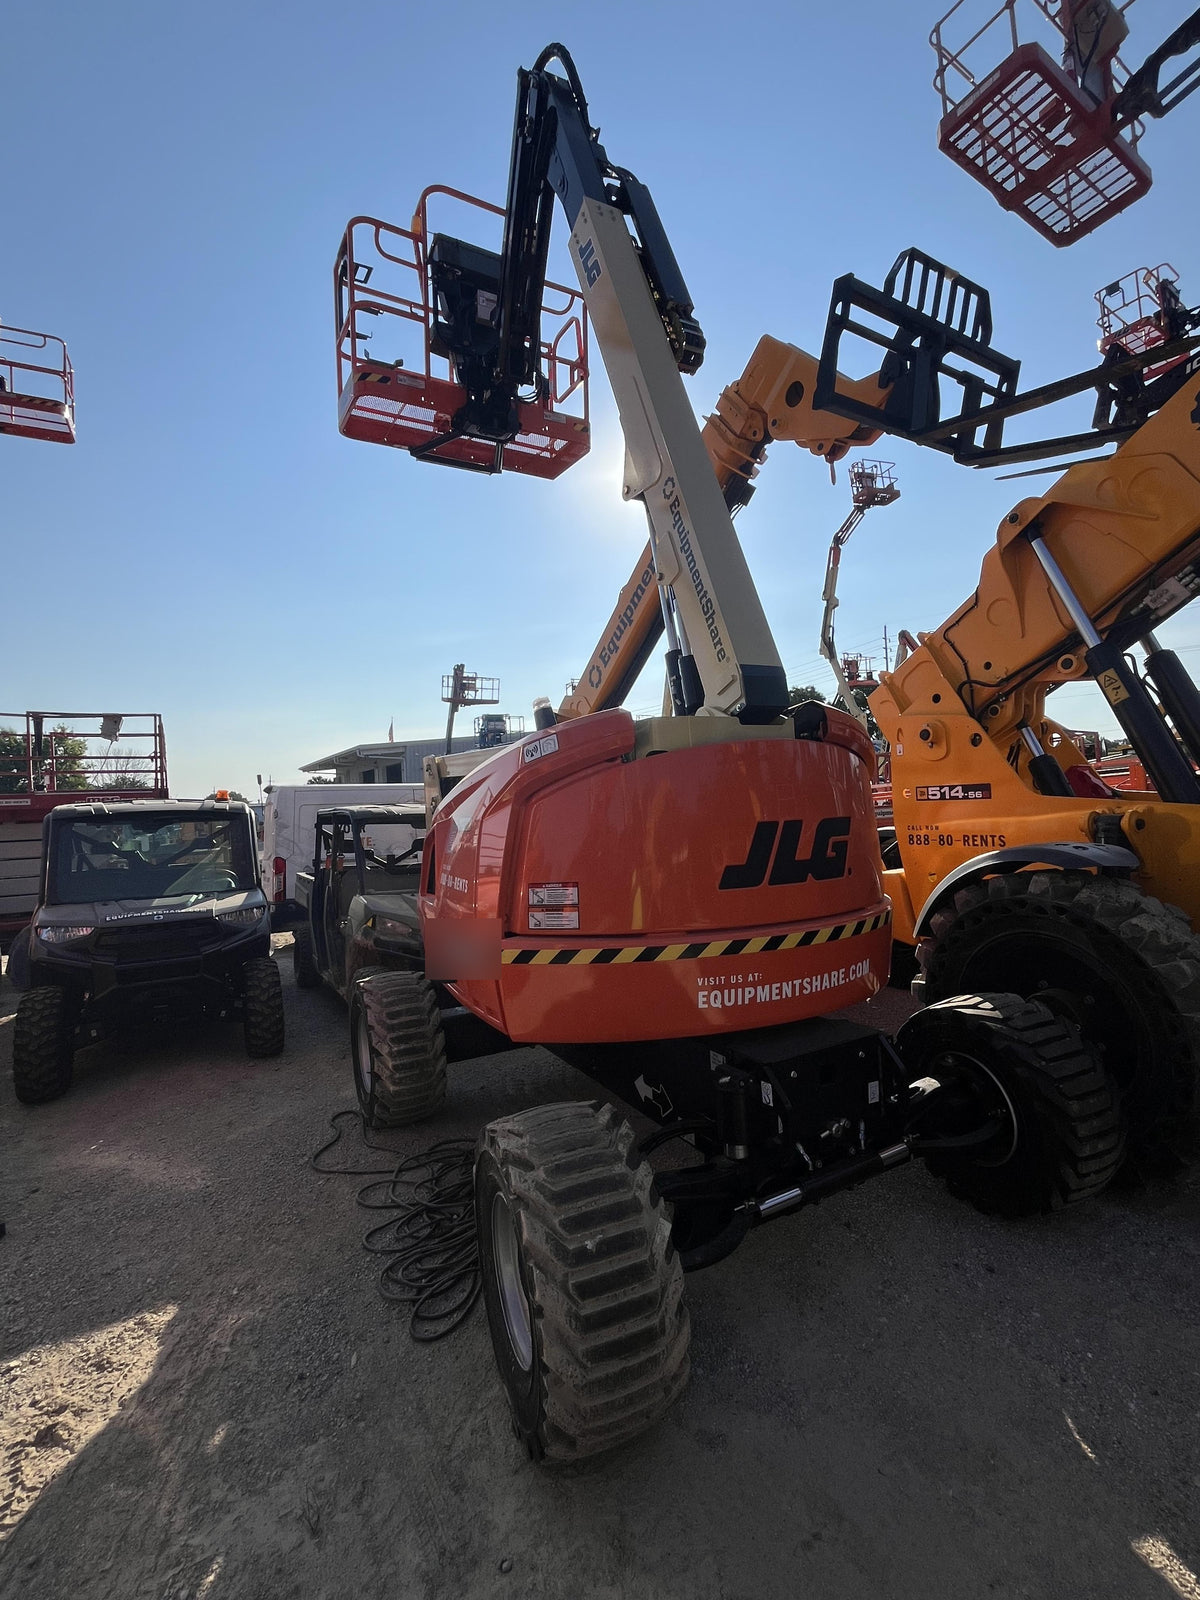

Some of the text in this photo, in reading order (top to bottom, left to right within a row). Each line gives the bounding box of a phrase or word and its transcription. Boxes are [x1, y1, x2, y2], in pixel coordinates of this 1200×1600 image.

[578, 238, 602, 289] JLG
[670, 495, 726, 662] EquipmentShare
[718, 816, 850, 890] JLG
[908, 834, 1006, 848] 888-80-RENTS
[697, 972, 763, 986] VISIT US AT:
[697, 958, 870, 1009] EQUIPMENTSHARE.COM
